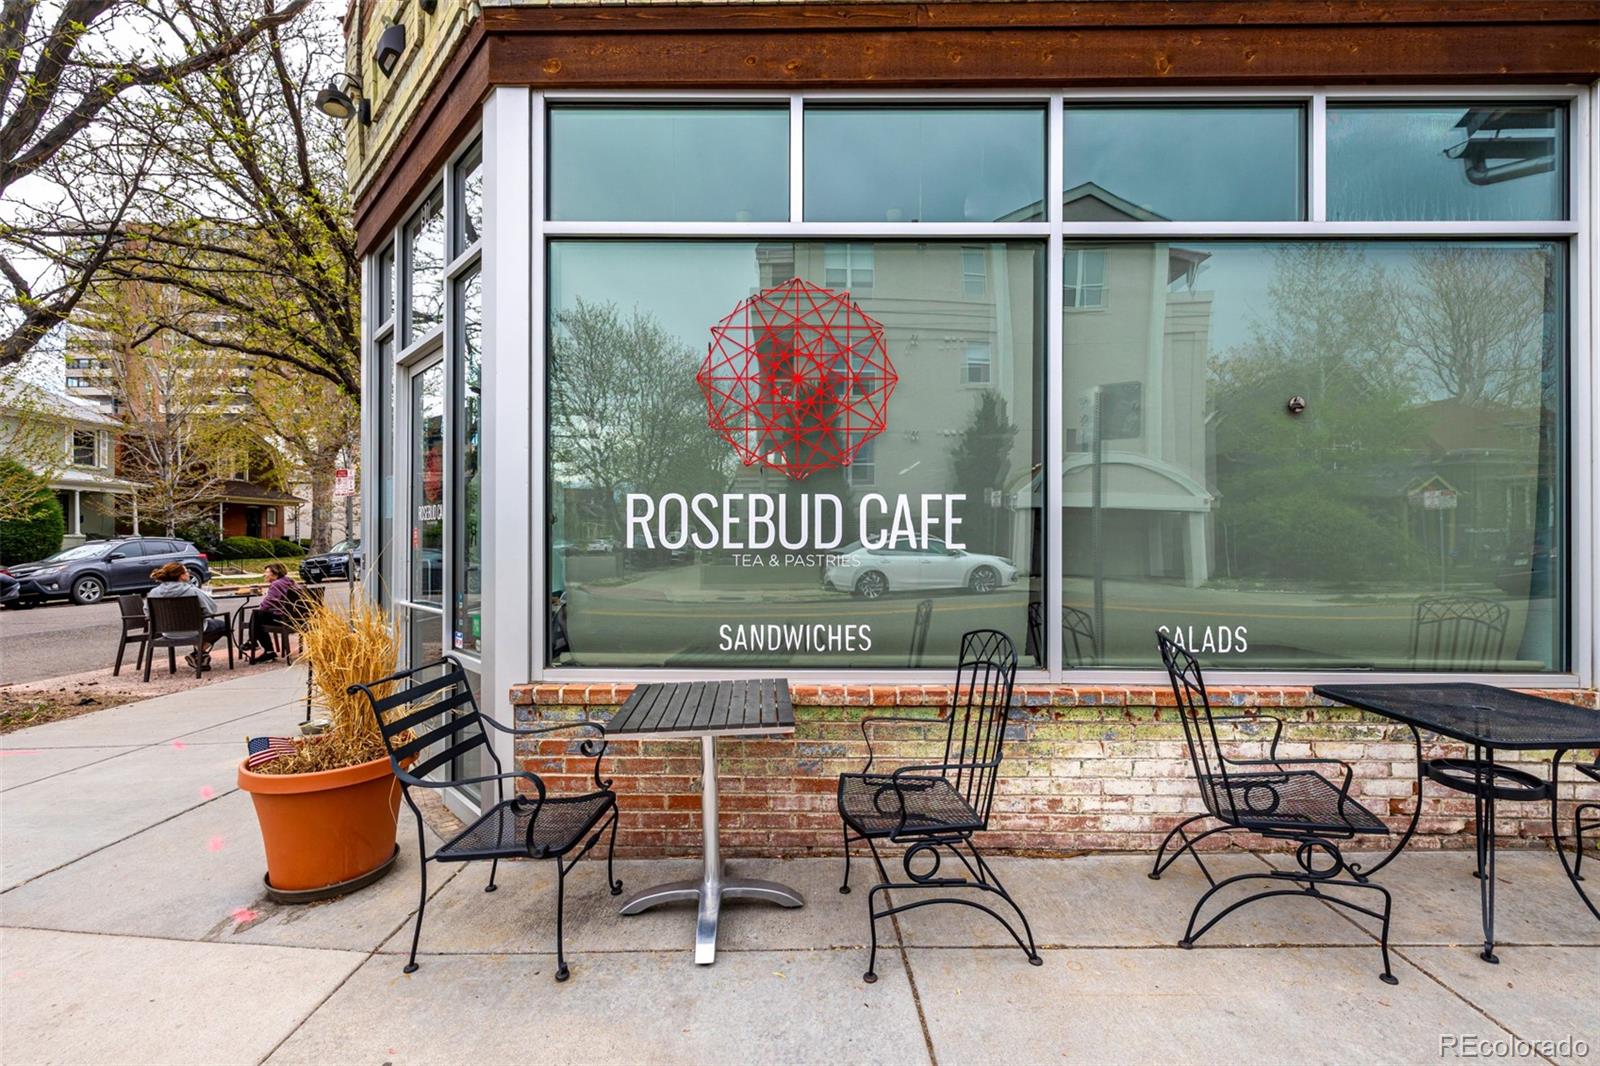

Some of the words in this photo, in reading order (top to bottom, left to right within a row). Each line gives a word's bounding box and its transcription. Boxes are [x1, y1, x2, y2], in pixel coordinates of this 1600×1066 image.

[626, 493, 843, 550] ROSEBUD
[859, 493, 966, 550] CAFE
[732, 554, 764, 567] TEA
[768, 554, 779, 567] &
[785, 554, 862, 567] PASTRIES
[719, 624, 872, 652] SANDWICHES
